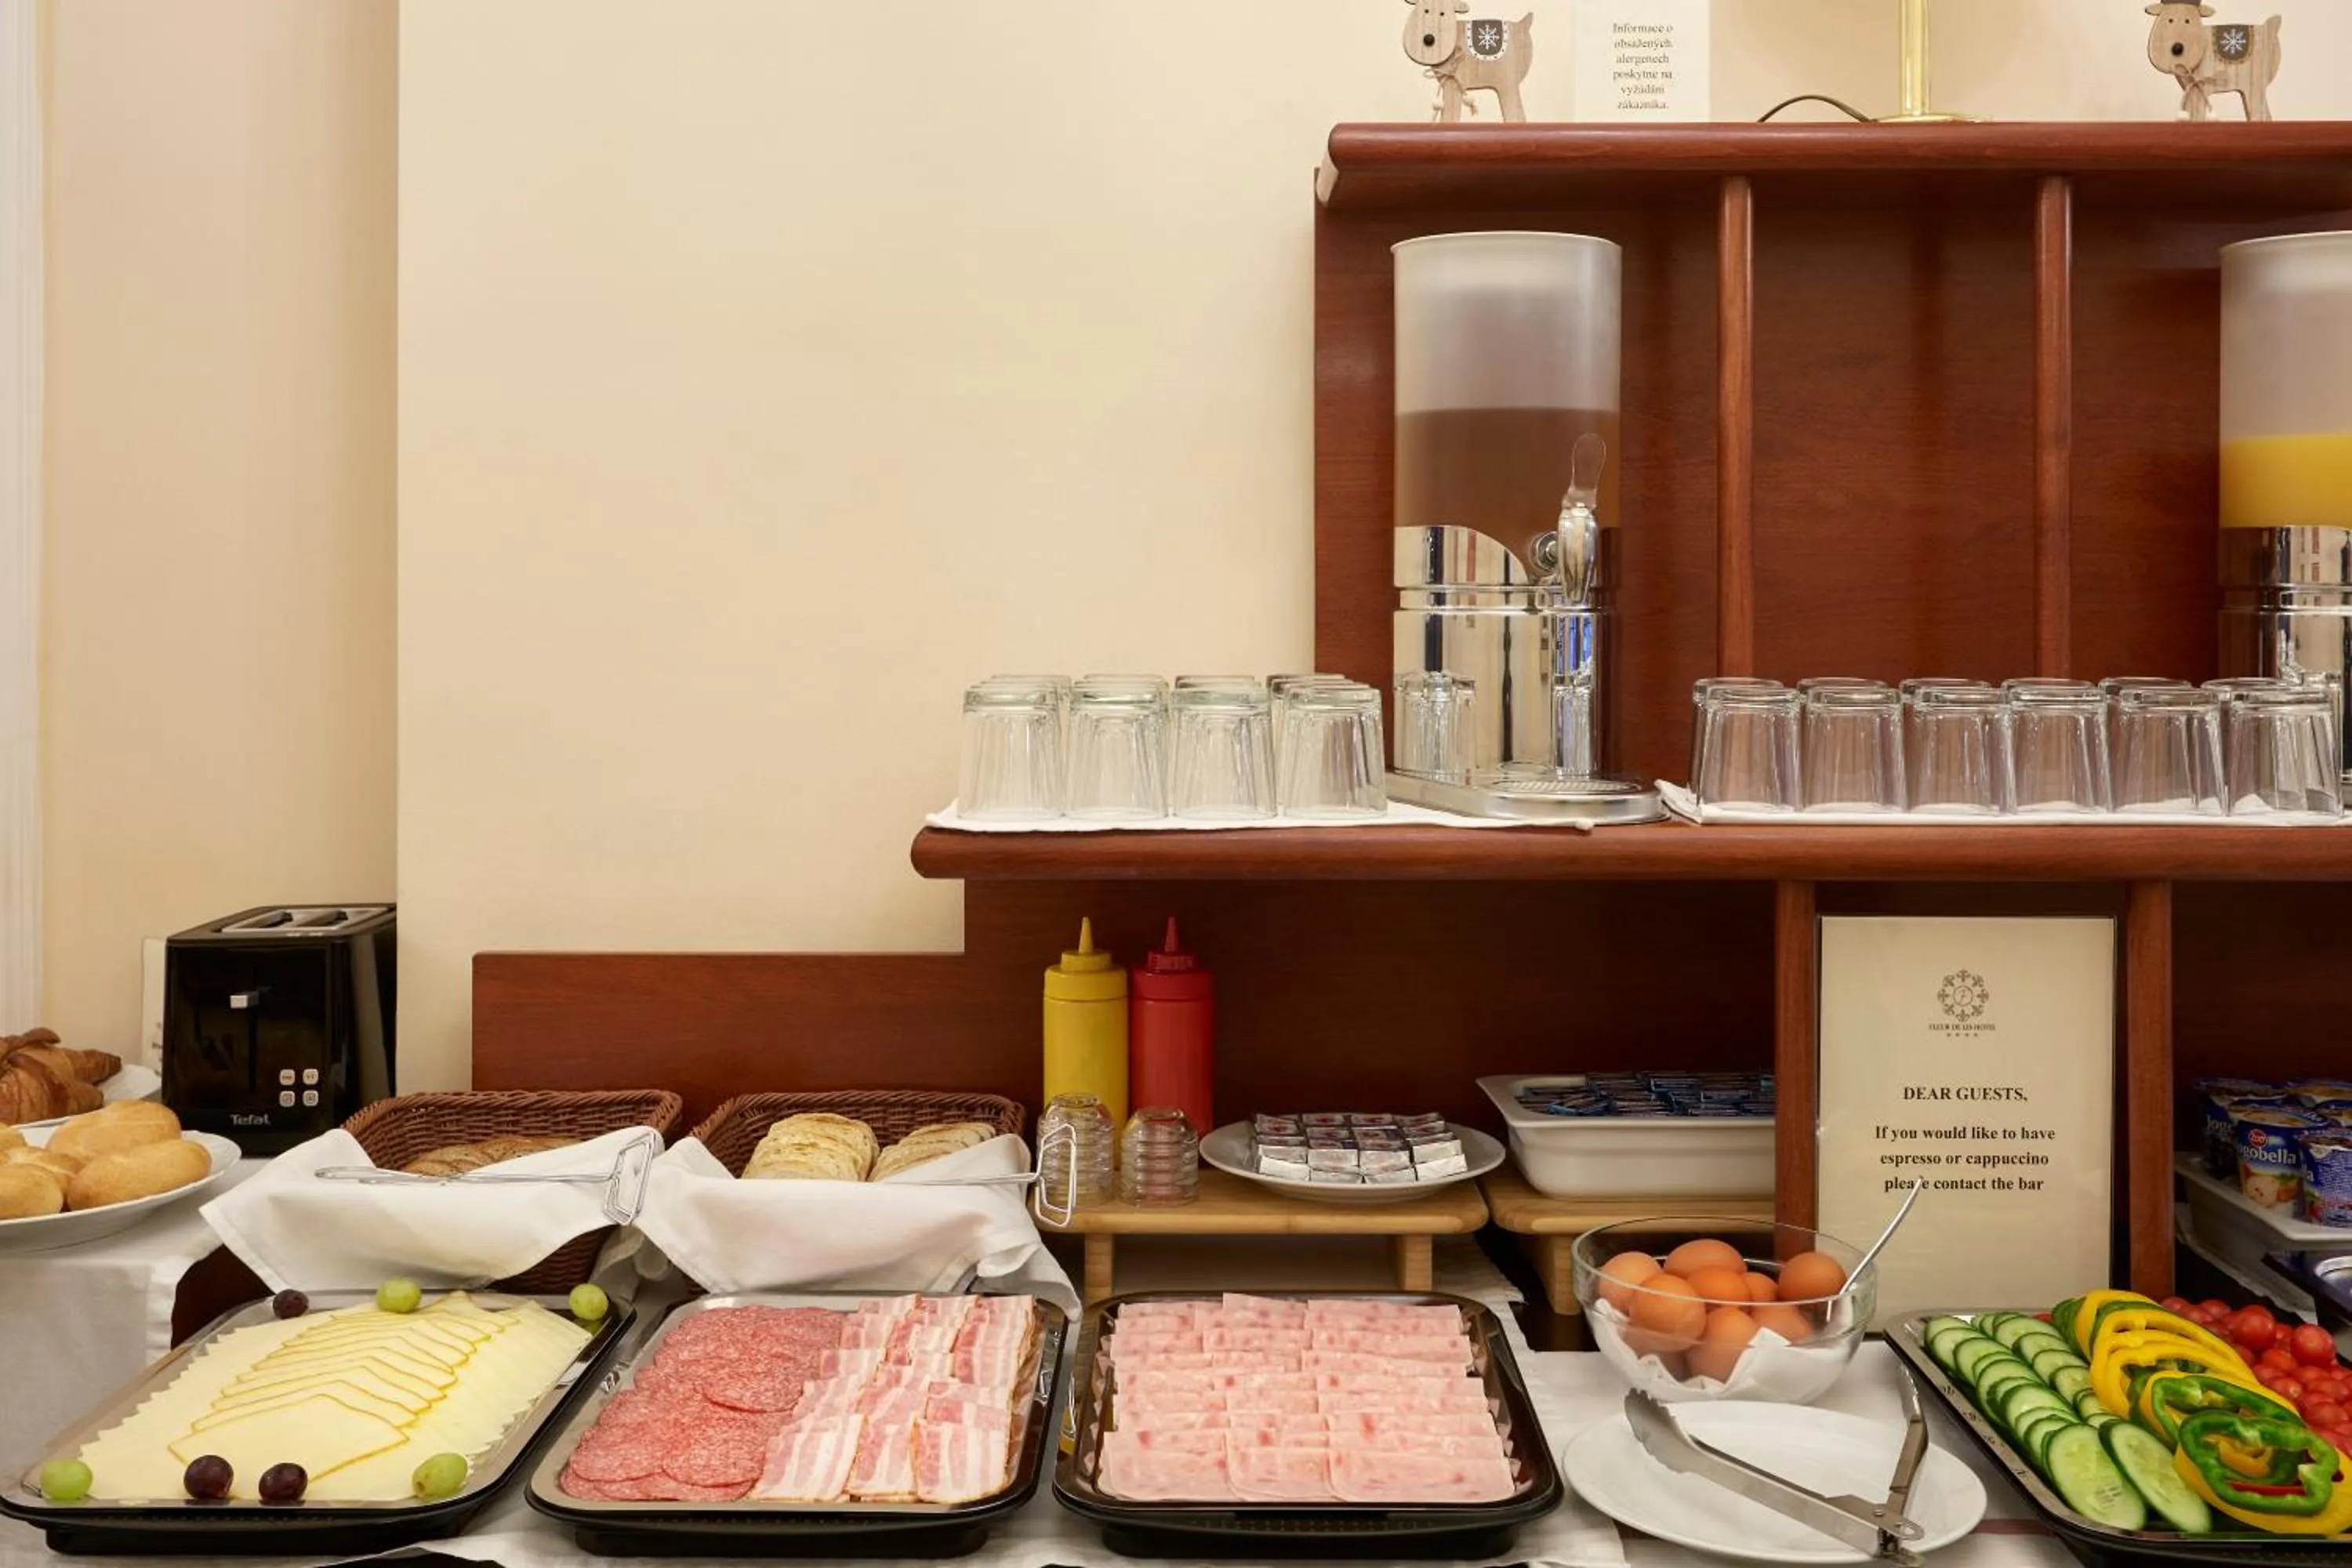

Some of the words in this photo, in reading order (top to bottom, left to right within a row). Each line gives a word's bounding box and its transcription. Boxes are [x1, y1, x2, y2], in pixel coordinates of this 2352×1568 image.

[1613, 22, 1664, 33] Informace
[1616, 53, 1669, 66] alergenech
[1613, 68, 1658, 82] poskytne
[1903, 1087, 1951, 1101] DEAR
[1955, 1087, 2029, 1102] GUESTS,
[229, 1113, 270, 1126] Tefal
[1875, 1125, 1889, 1139] If
[1890, 1128, 1918, 1142] you
[1922, 1125, 1968, 1140] would
[1971, 1126, 1998, 1139] like
[2002, 1127, 2016, 1140] to
[2020, 1126, 2056, 1140] have
[1880, 1154, 1942, 1167] espresso
[1945, 1154, 1962, 1166] or
[1965, 1152, 2049, 1169] cappuccino
[1884, 1177, 1929, 1193] pleae
[1933, 1178, 1987, 1191] contact
[1991, 1177, 2014, 1191] the
[2019, 1178, 2045, 1191] bar
